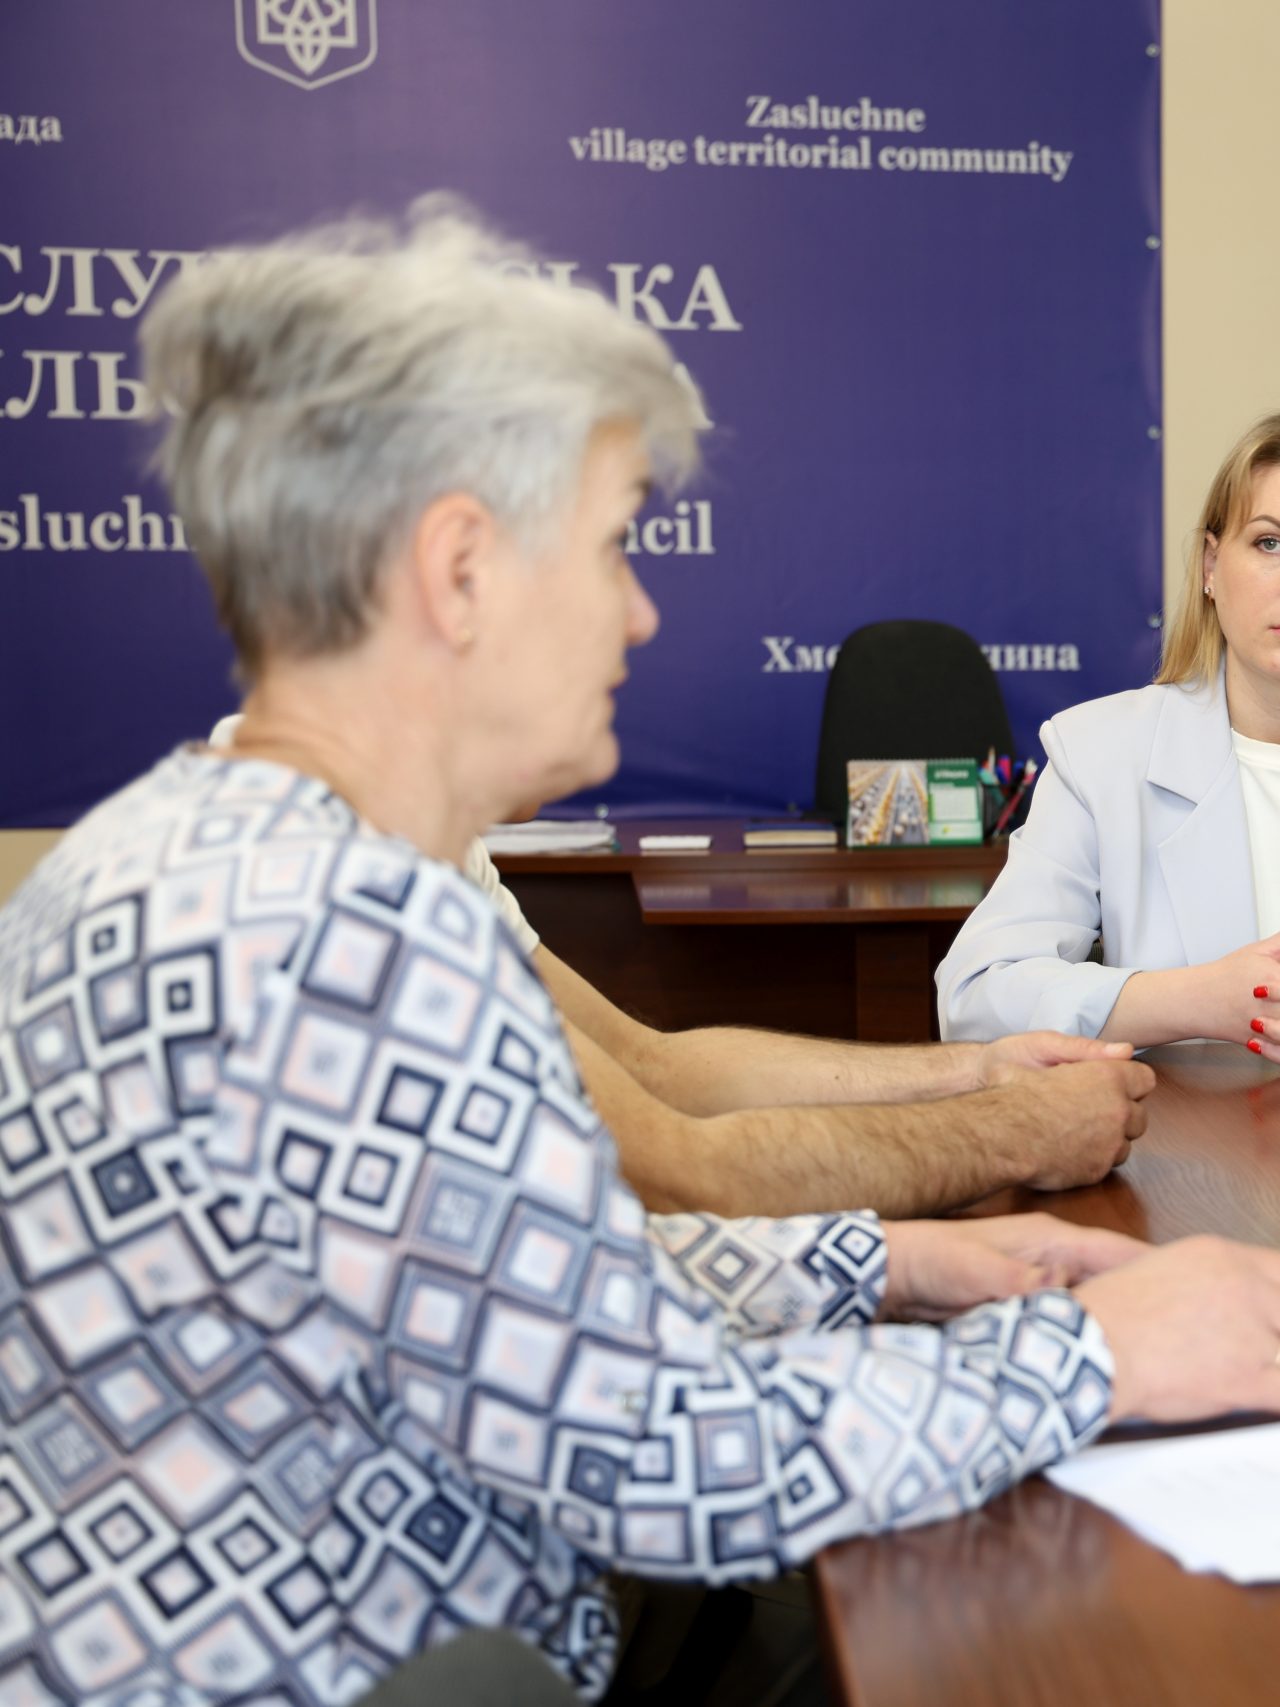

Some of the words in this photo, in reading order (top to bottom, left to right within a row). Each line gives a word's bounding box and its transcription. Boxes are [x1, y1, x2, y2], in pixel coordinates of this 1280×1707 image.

[746, 95, 926, 133] Zasluchne
[568, 127, 688, 172] village
[693, 134, 872, 170] territorial
[877, 140, 1073, 183] community
